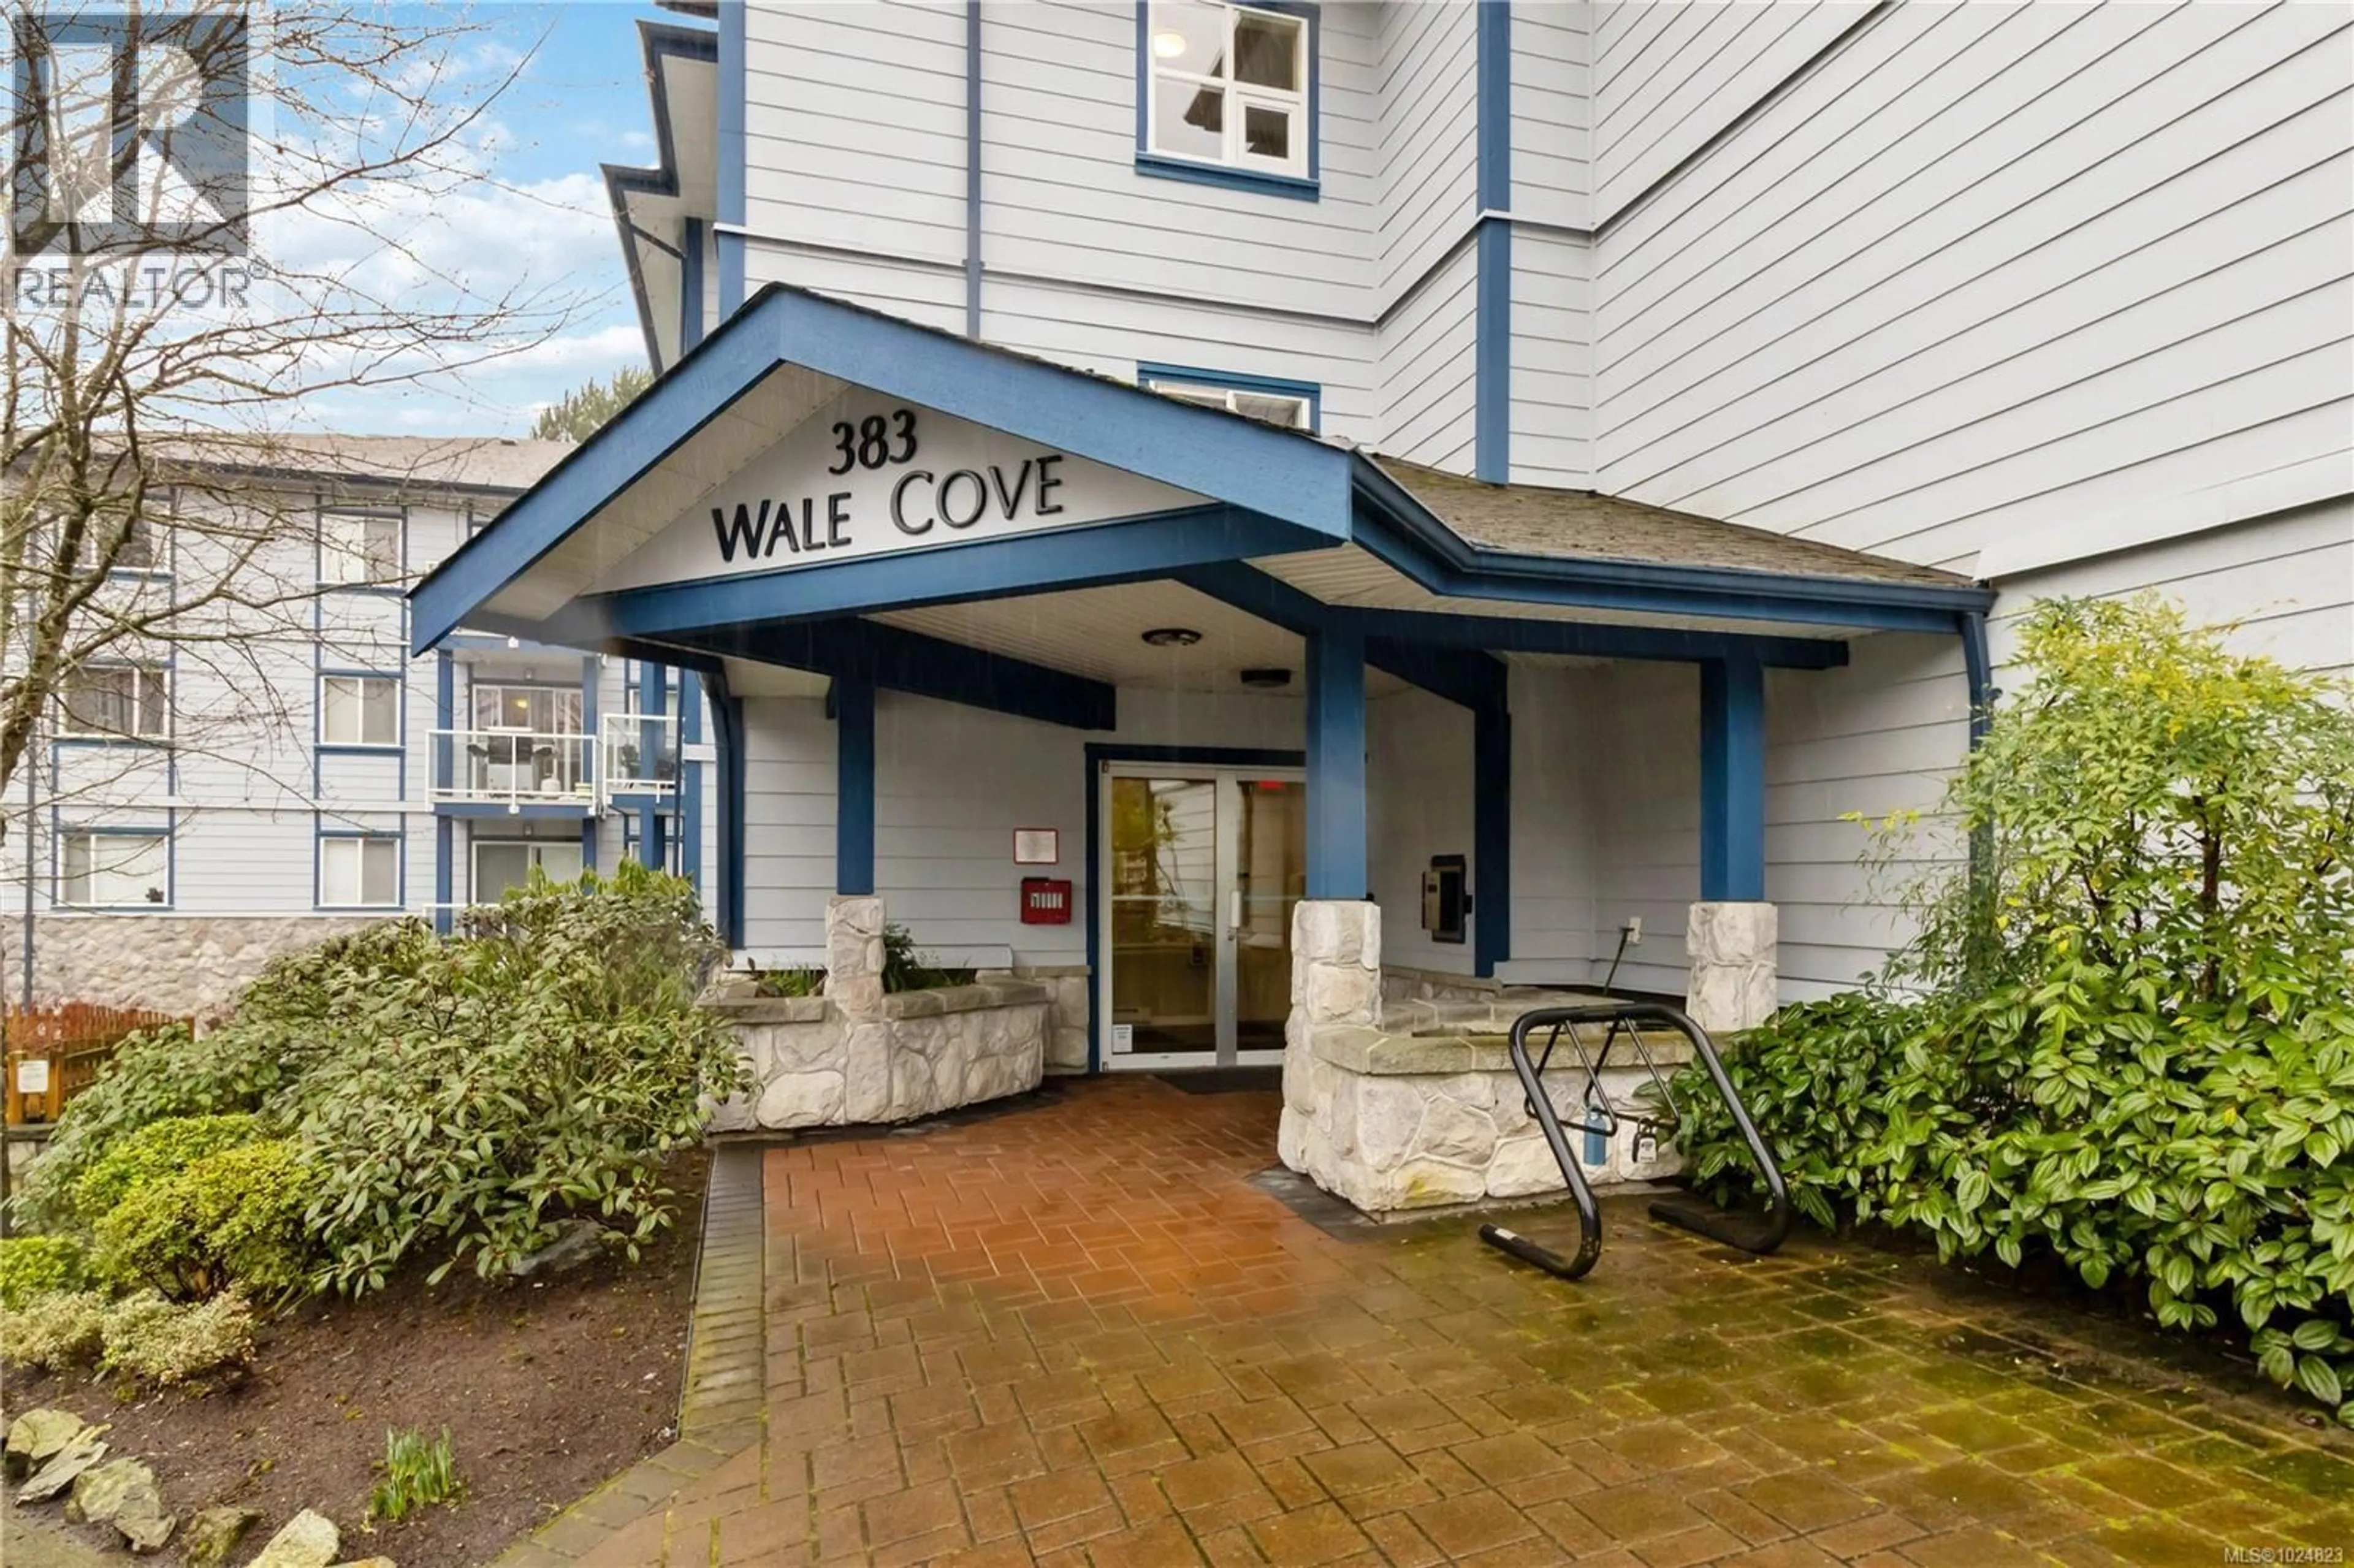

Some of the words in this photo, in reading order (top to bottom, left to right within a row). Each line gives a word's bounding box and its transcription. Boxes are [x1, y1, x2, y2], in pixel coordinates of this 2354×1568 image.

[828, 409, 918, 475] 383
[711, 492, 851, 563] WALE
[889, 455, 1064, 536] COVE
